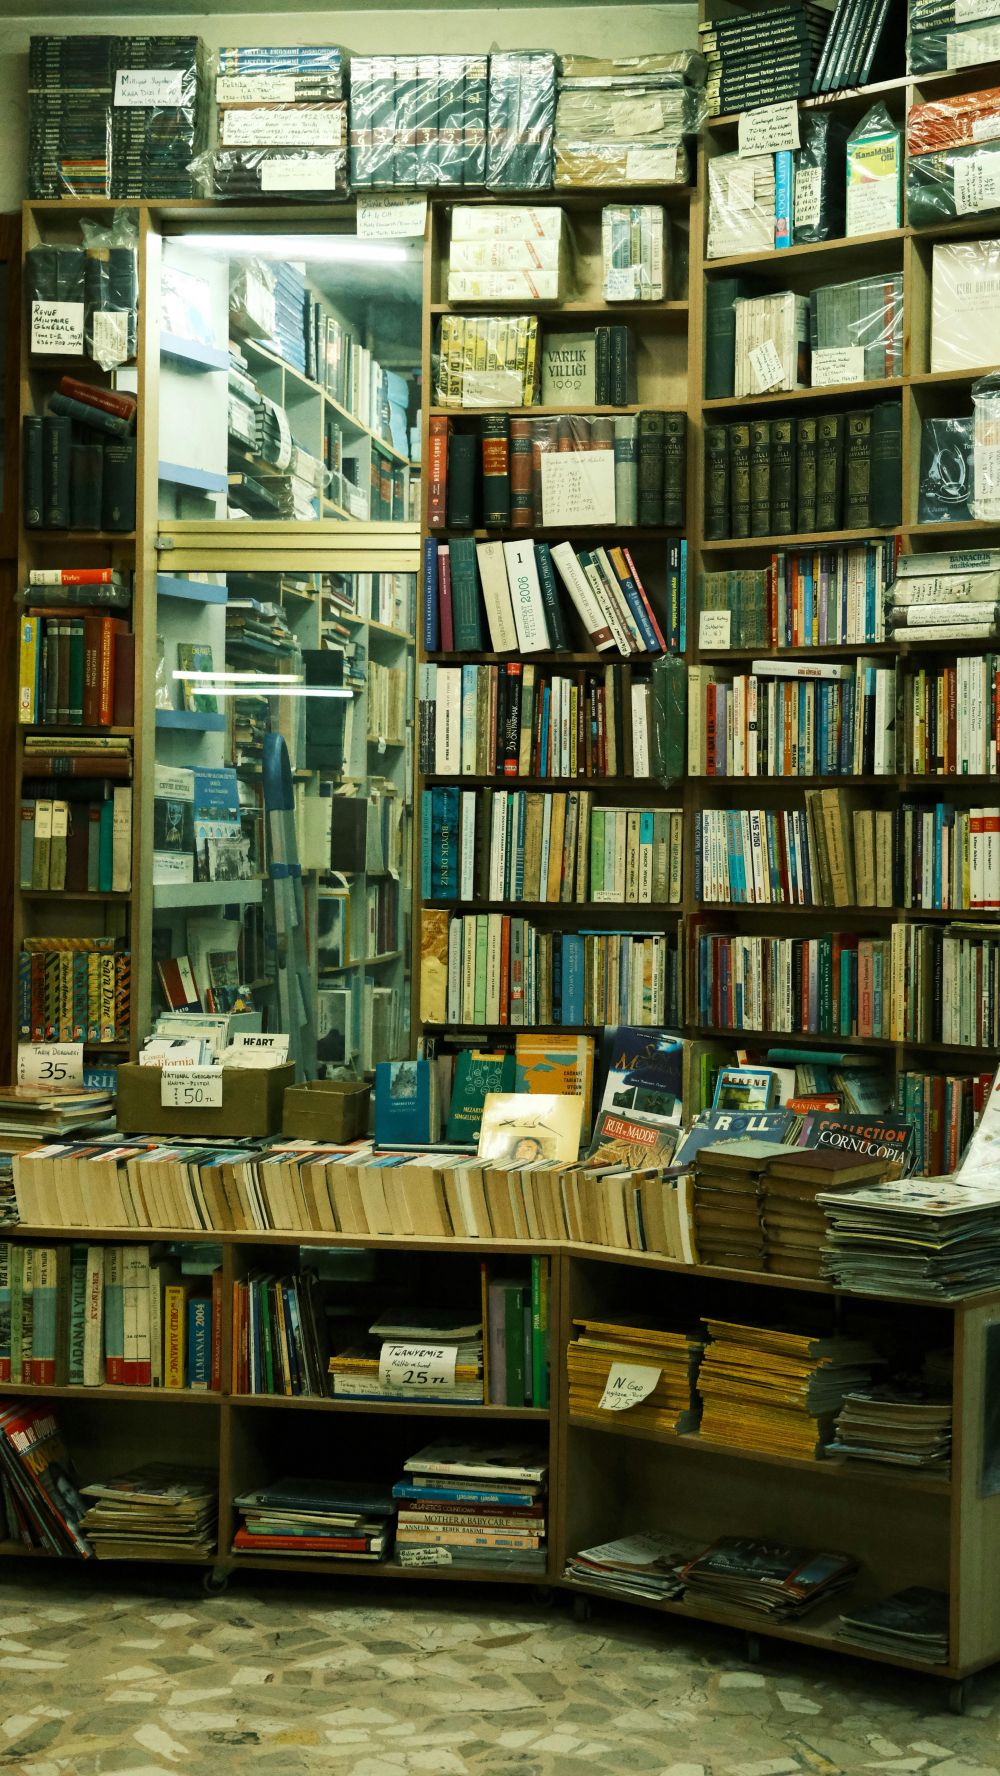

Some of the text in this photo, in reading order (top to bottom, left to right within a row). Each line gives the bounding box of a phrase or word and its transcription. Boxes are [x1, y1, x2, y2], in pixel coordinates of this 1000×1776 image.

[776, 151, 789, 218] EAUTY BOOK
[548, 350, 586, 362] VARLIK
[548, 363, 586, 377] YILLIĞI
[516, 552, 523, 564] 1
[518, 576, 531, 603] 2006
[752, 816, 760, 831] MS
[102, 960, 114, 1018] Sara Dane
[243, 1038, 274, 1046] HEART
[38, 1061, 67, 1080] 35
[143, 1058, 194, 1066] California
[162, 1072, 190, 1080] NATIONAL
[184, 1088, 203, 1104] 50
[606, 1119, 624, 1133] RUH
[627, 1126, 656, 1143] MADDE
[714, 1115, 771, 1132] ROLL
[819, 1120, 906, 1142] COLLECTION
[819, 1130, 905, 1164] CORNUCOPIA
[91, 1272, 99, 1320] ERZİNCAN
[74, 1320, 84, 1368] ADANA
[195, 1304, 204, 1380] ALMANAK 2004
[170, 1332, 179, 1373] ALMANAC
[402, 1370, 428, 1384] 25
[424, 1515, 459, 1524] MOTHER
[467, 1517, 487, 1525] BABY
[488, 1518, 511, 1526] CARE
